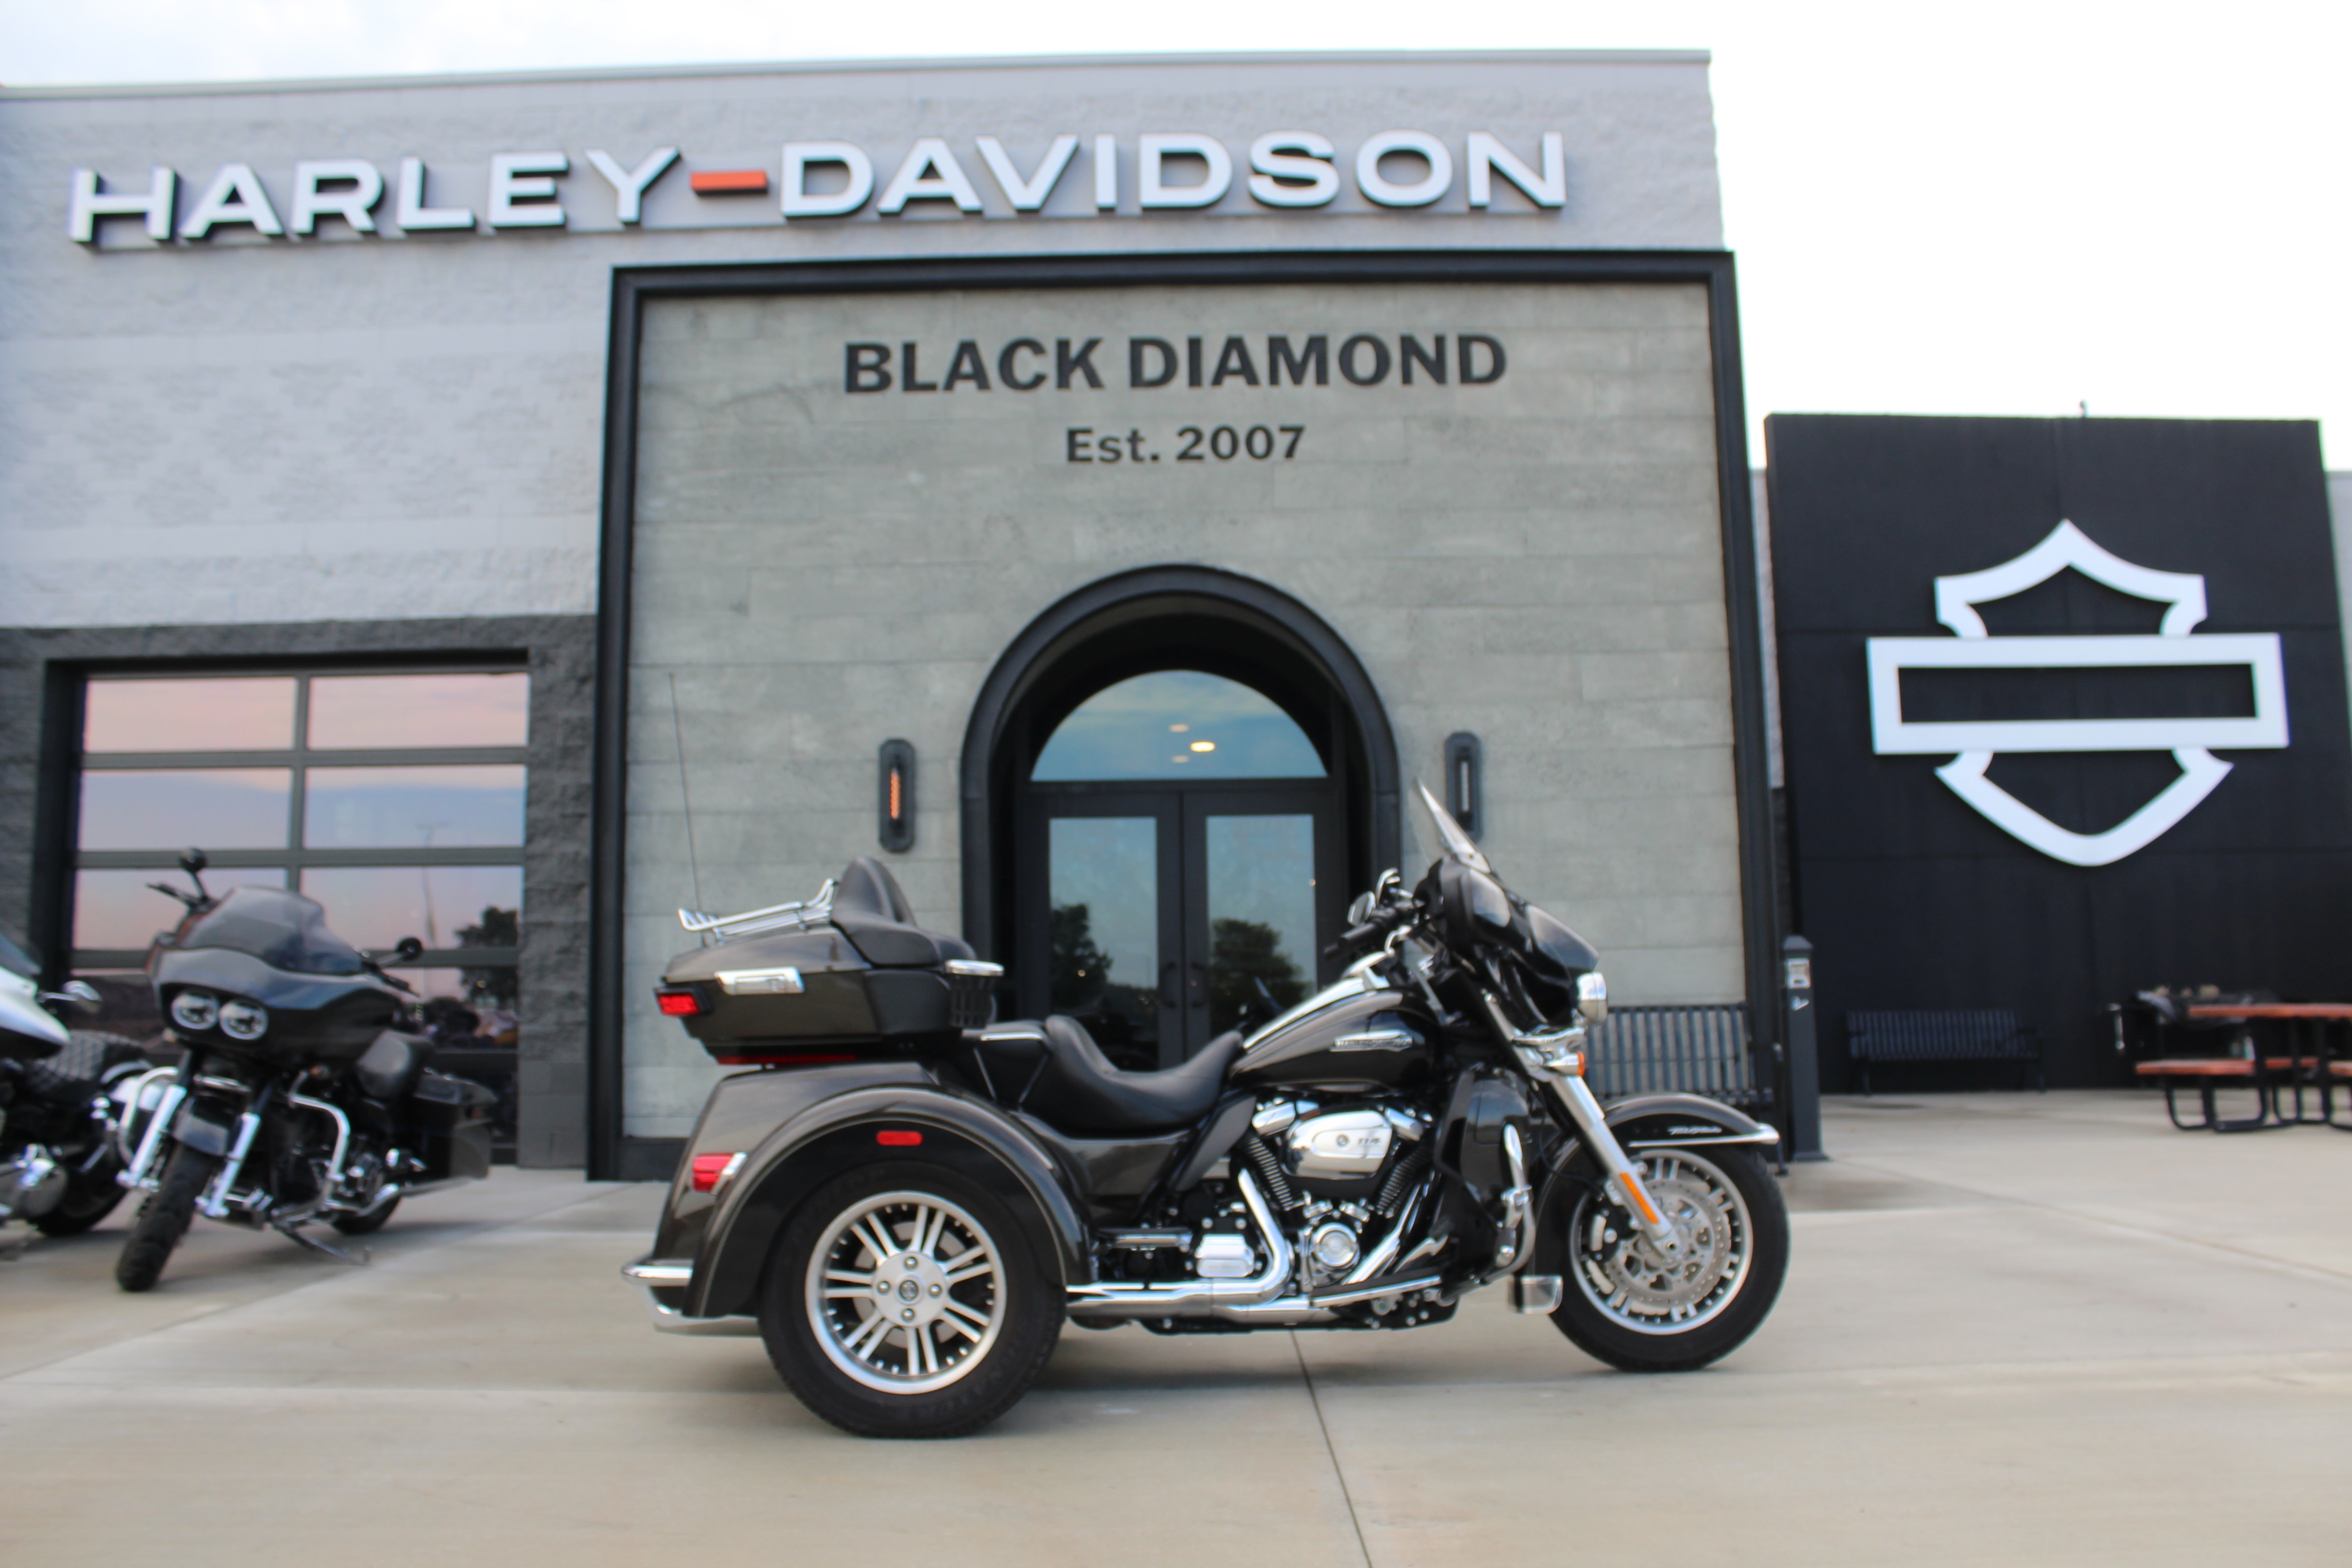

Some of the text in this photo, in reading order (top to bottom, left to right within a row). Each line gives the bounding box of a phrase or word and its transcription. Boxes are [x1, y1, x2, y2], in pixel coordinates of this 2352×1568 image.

[68, 128, 1567, 243] HARLEY-DAVIDSON
[845, 333, 1508, 393] BLACK DIAMOND
[1067, 425, 1306, 463] Est. 2007
